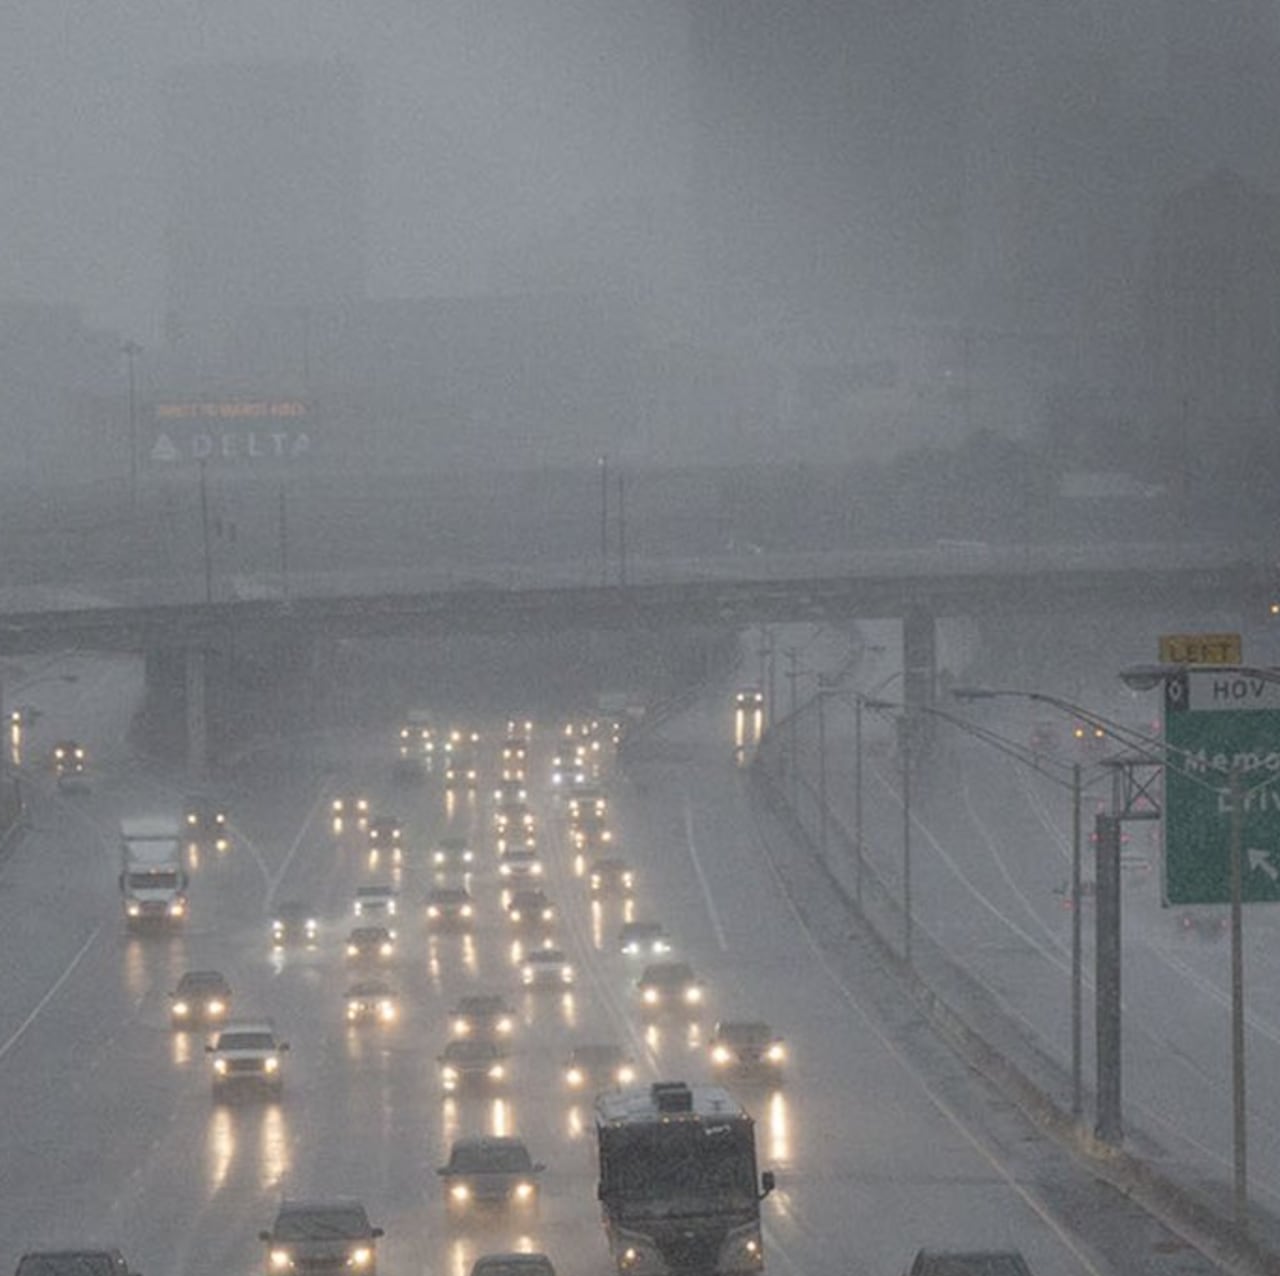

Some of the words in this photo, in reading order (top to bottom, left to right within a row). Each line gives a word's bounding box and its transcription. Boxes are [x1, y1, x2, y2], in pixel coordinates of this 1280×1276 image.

[192, 433, 310, 458] DELTA
[1169, 642, 1232, 663] LEFT
[1214, 678, 1265, 700] HOV
